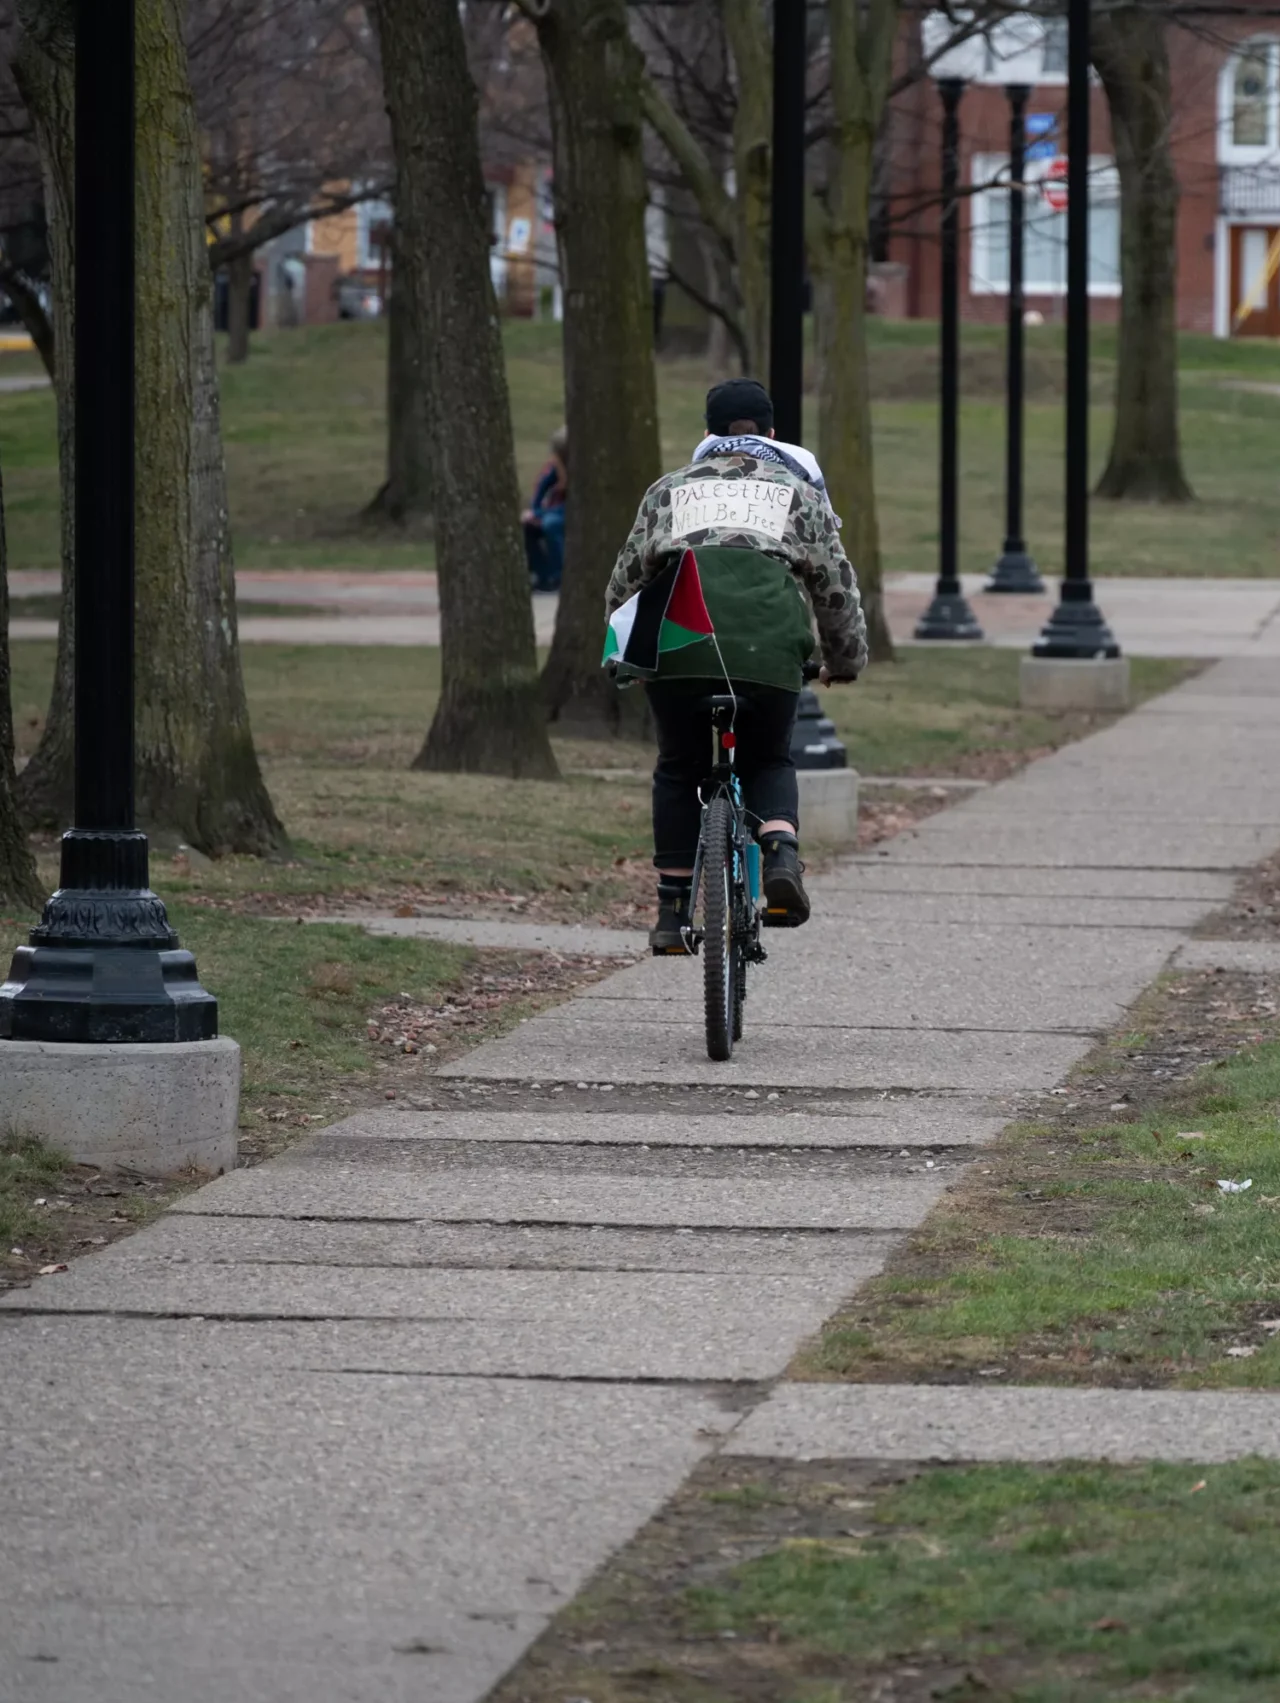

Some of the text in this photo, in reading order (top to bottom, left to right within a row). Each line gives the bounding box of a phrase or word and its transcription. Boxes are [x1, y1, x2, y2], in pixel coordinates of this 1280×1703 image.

[675, 503, 776, 533] Will Be Free
